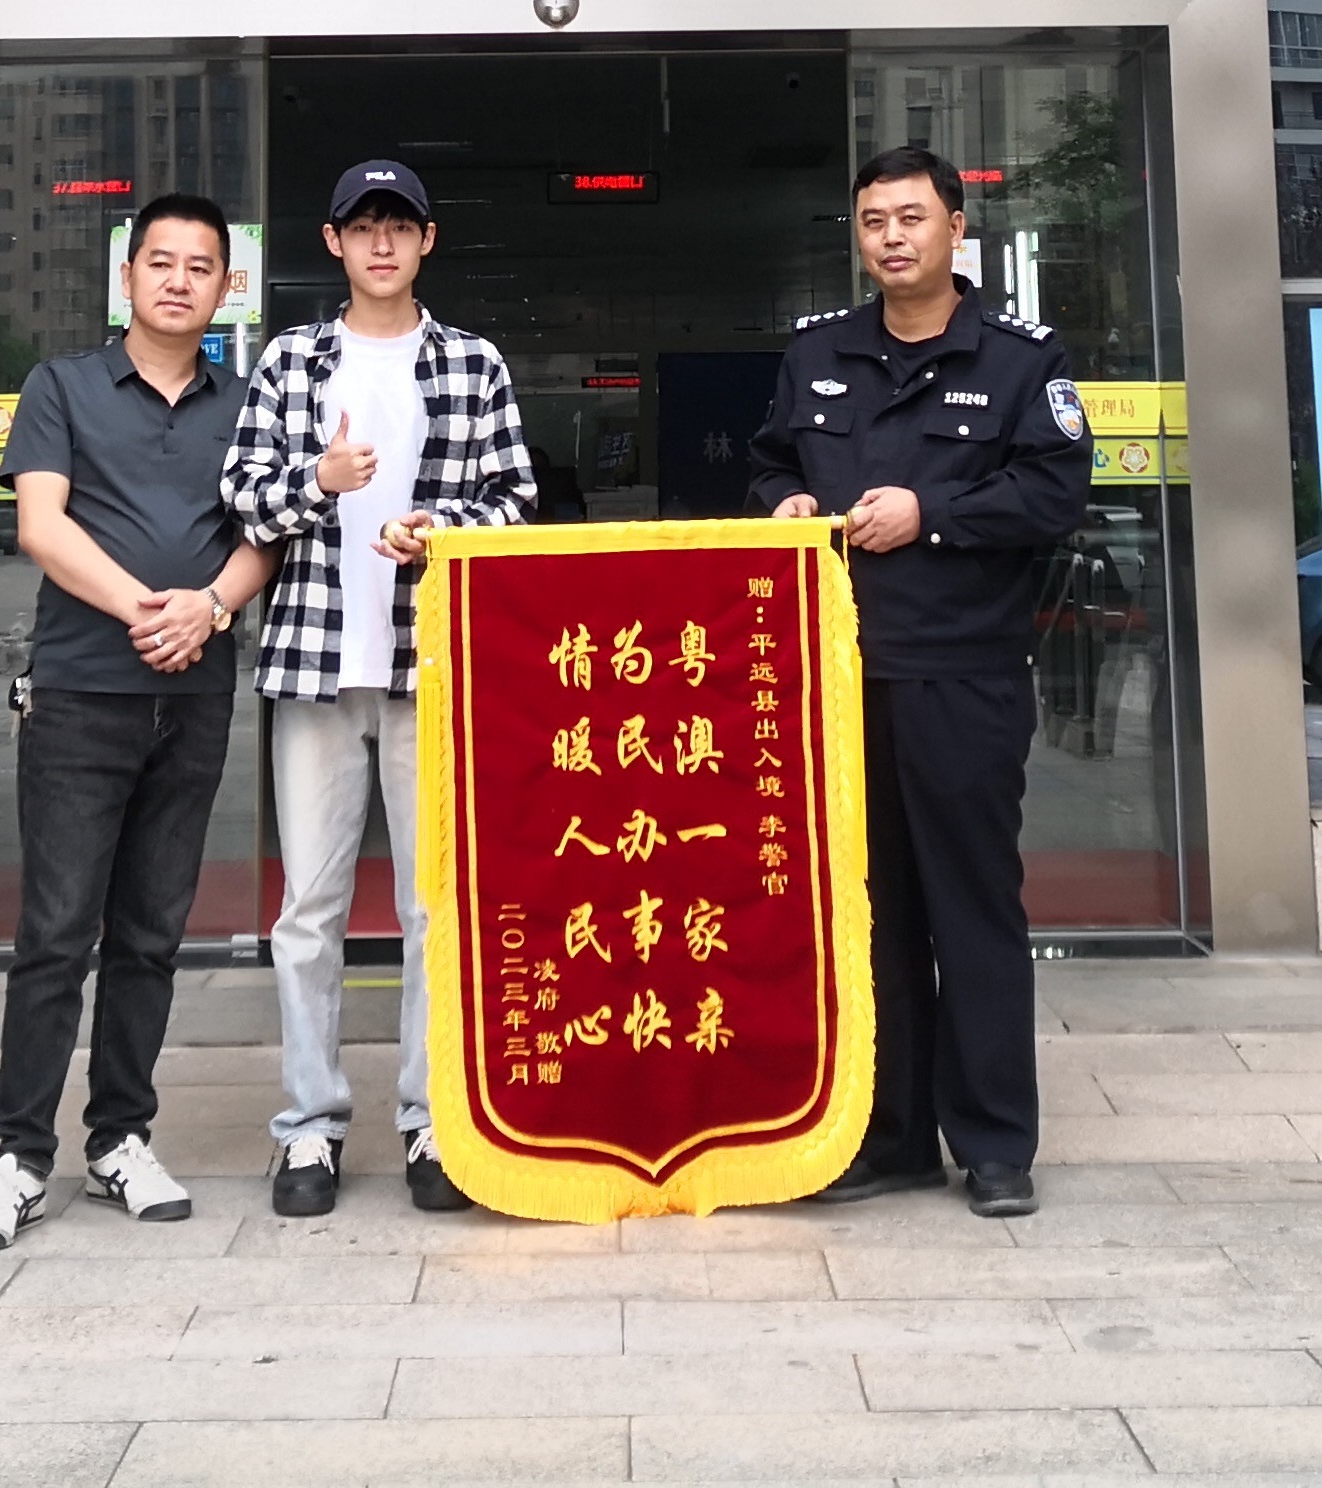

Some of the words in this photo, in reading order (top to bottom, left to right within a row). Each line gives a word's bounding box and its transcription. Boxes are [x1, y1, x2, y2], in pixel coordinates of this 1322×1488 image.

[548, 623, 613, 1049] 情暖人民心
[610, 619, 673, 1053] 为民办事快
[668, 620, 735, 1055] 粤澳一家亲
[747, 577, 785, 798] 赠：平远县出入境
[498, 904, 532, 1086] 二〇二三年三月
[535, 1031, 563, 1085] 敬赠
